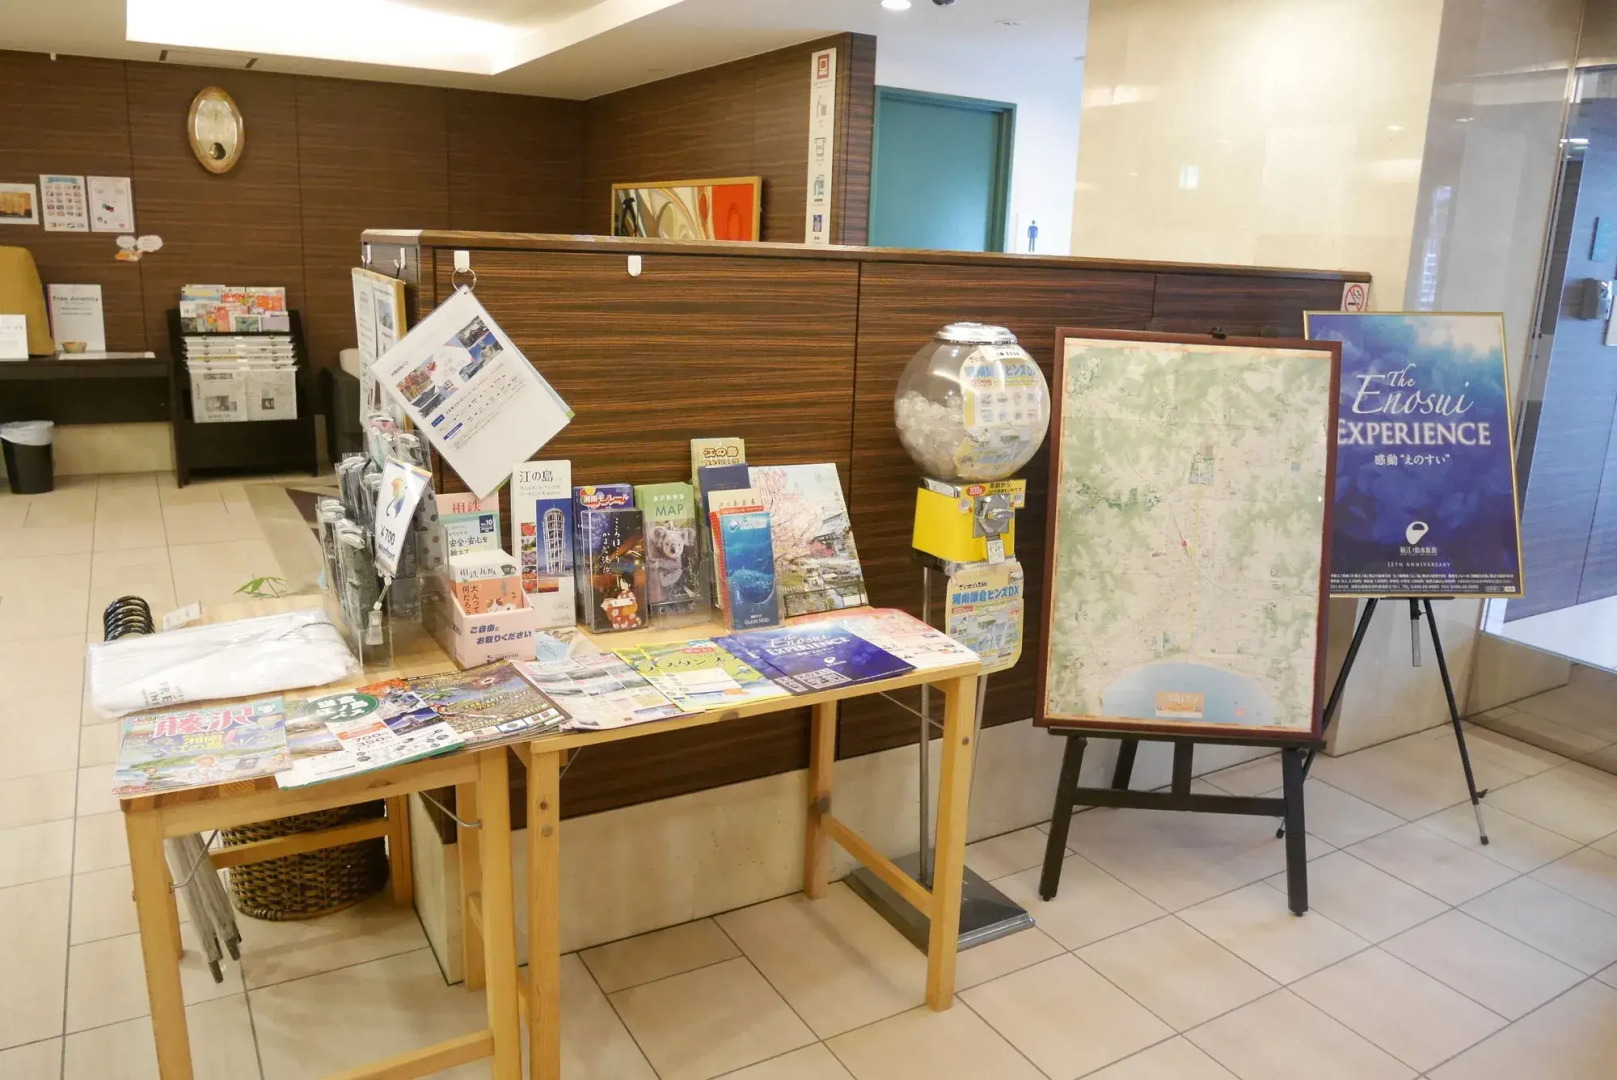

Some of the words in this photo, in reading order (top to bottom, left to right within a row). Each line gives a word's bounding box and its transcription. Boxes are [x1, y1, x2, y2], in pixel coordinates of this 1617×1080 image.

[1386, 362, 1417, 388] The
[1351, 374, 1475, 417] Enosui
[1338, 419, 1492, 446] EXPERIENCE
[703, 445, 740, 459] 江の島
[518, 470, 554, 483] 江の島
[582, 492, 630, 506] 湘南モノレール
[655, 503, 685, 517] MAP
[449, 536, 488, 548] 安全・安心を
[758, 616, 770, 624] Map
[476, 630, 532, 645] お取りください
[765, 636, 851, 656] EXPERIENCE
[153, 706, 255, 739] 藤沢
